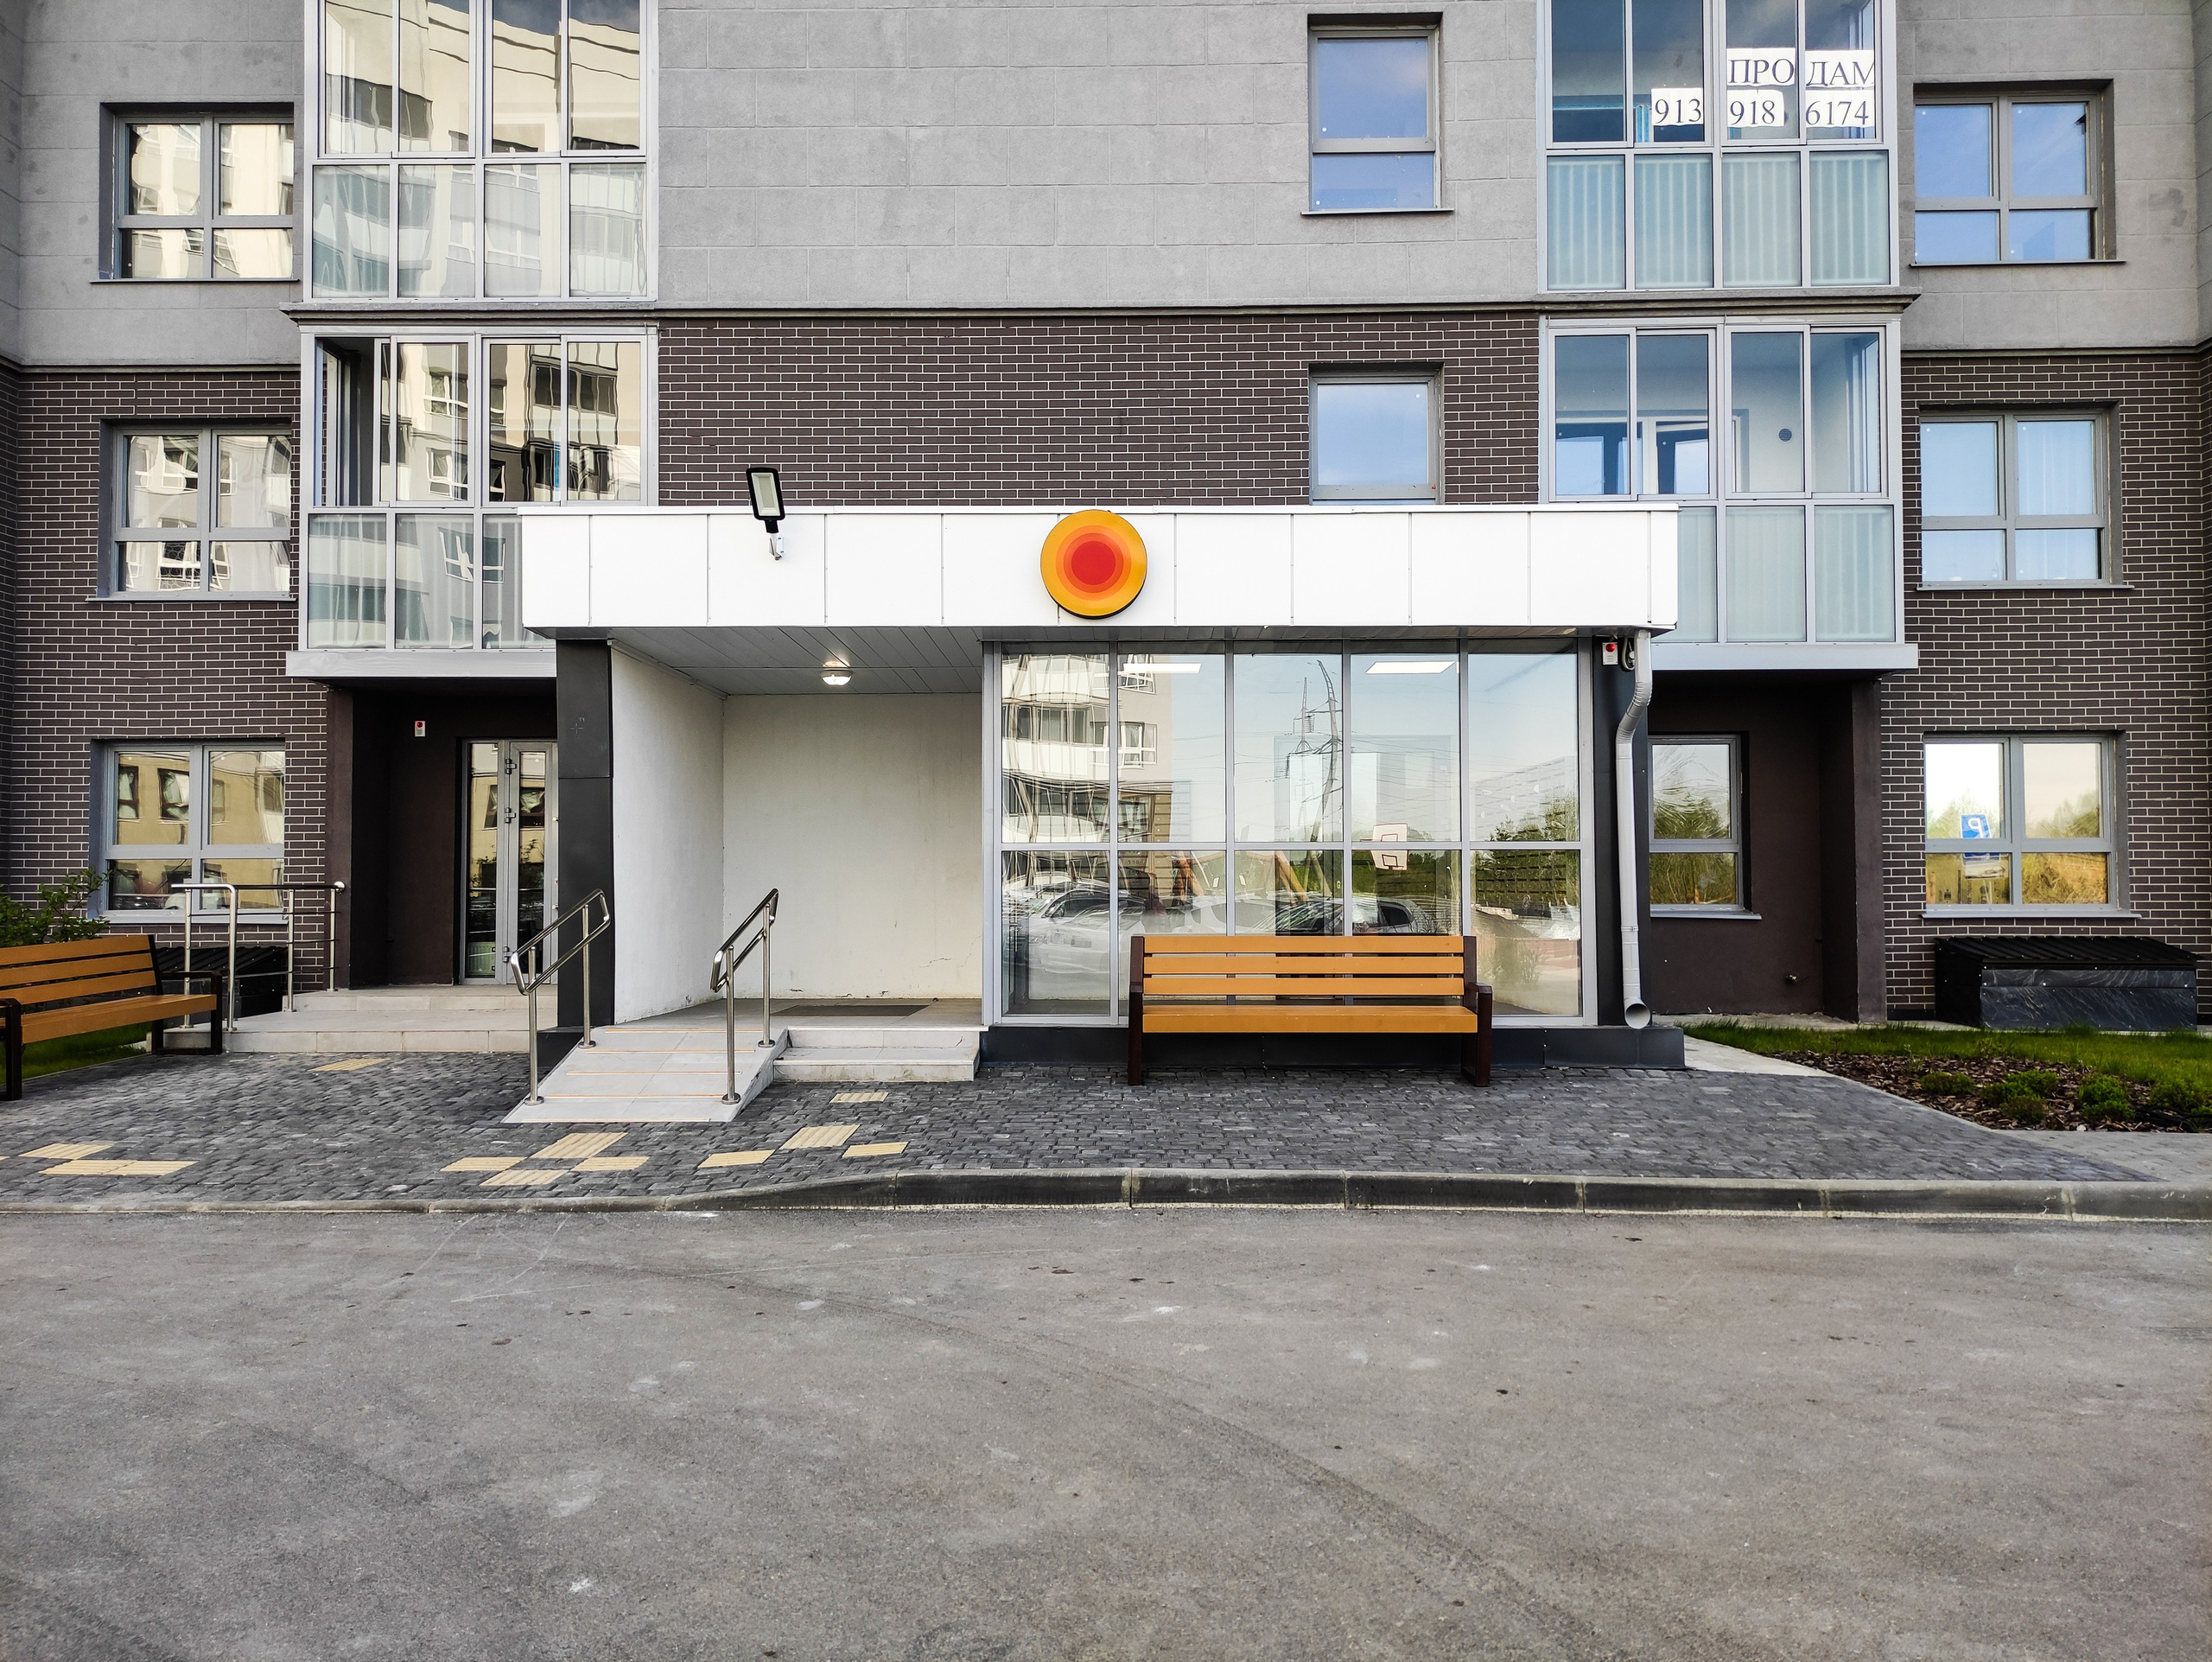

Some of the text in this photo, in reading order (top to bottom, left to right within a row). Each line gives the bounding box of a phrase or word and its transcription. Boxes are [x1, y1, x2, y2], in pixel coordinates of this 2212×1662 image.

[1655, 98, 1869, 125] 913 918 6174
